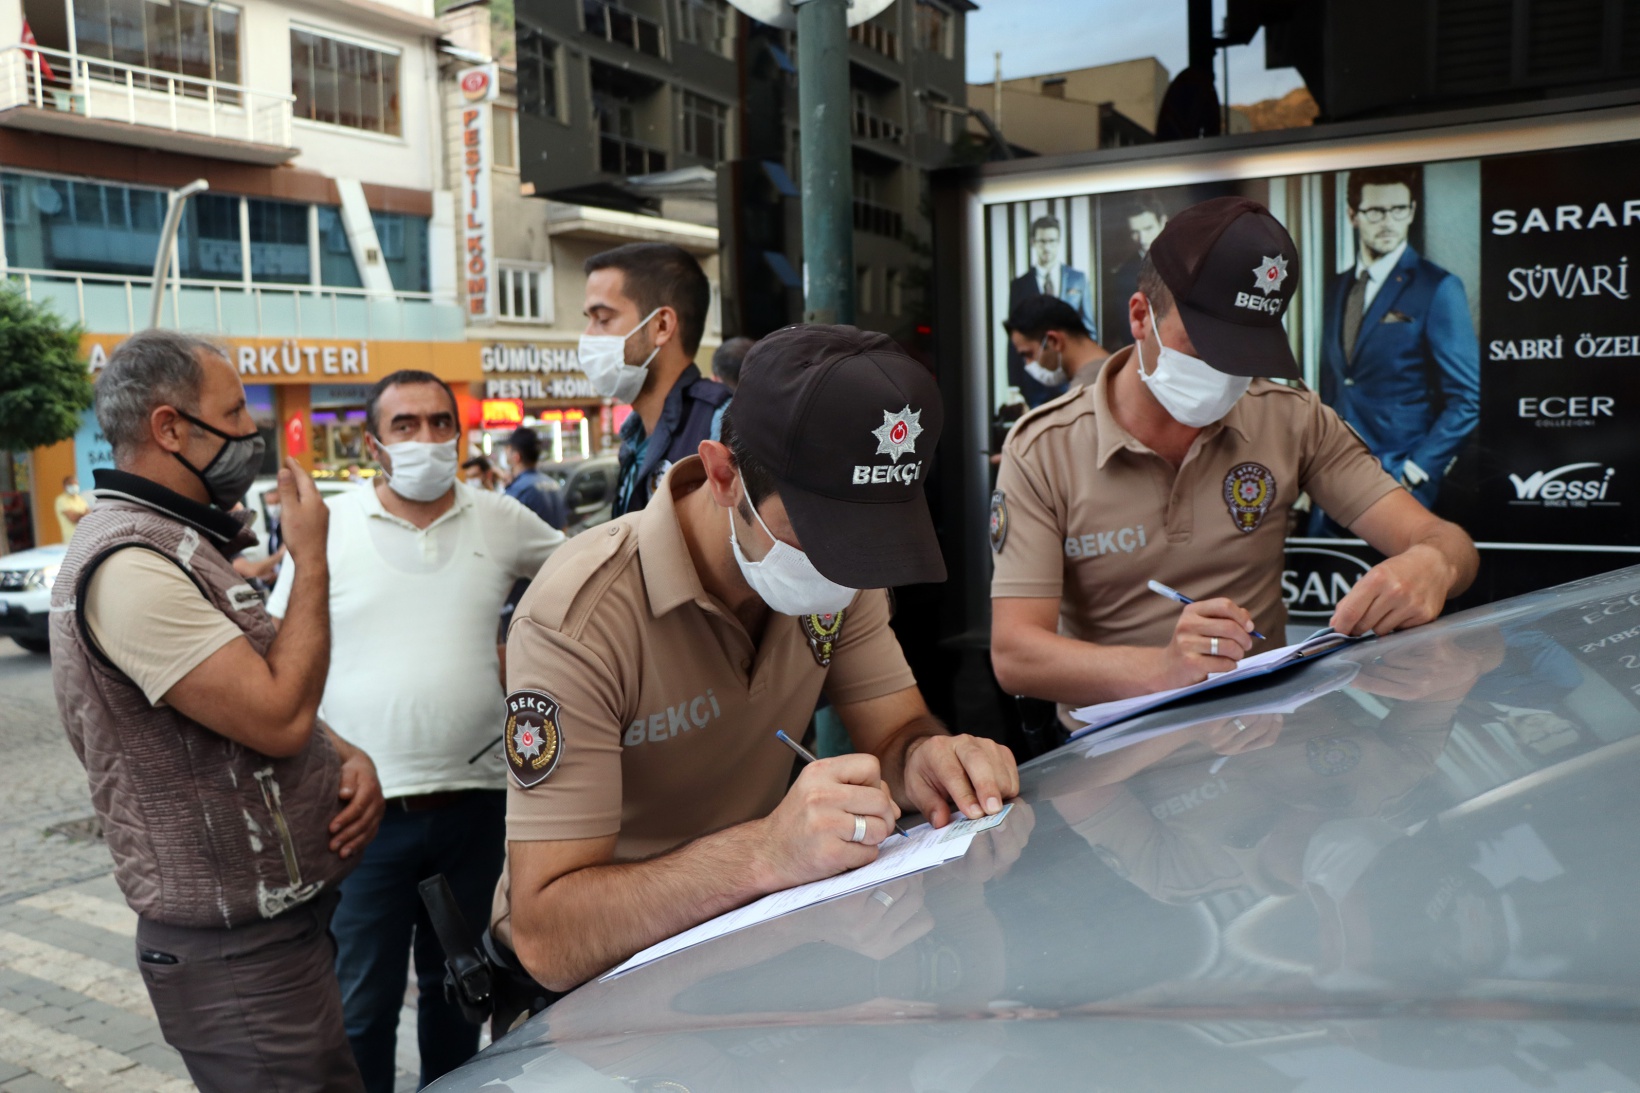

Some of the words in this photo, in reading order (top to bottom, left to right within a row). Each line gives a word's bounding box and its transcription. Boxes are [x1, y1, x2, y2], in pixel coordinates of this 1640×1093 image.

[1508, 256, 1630, 302] SÜVARİ
[1234, 291, 1283, 316] BEKÇİ
[238, 339, 369, 375] RKÜTERİ
[481, 344, 581, 375] GÜMÜŞHA
[1489, 334, 1563, 361] SABRİ
[1518, 396, 1615, 418] ECER
[852, 460, 922, 485] BEKÇİ
[1508, 462, 1616, 500] Wessi
[1064, 525, 1147, 558] BEKÇİ
[510, 697, 553, 716] BEKÇİ
[624, 688, 721, 747] BEKÇİ
